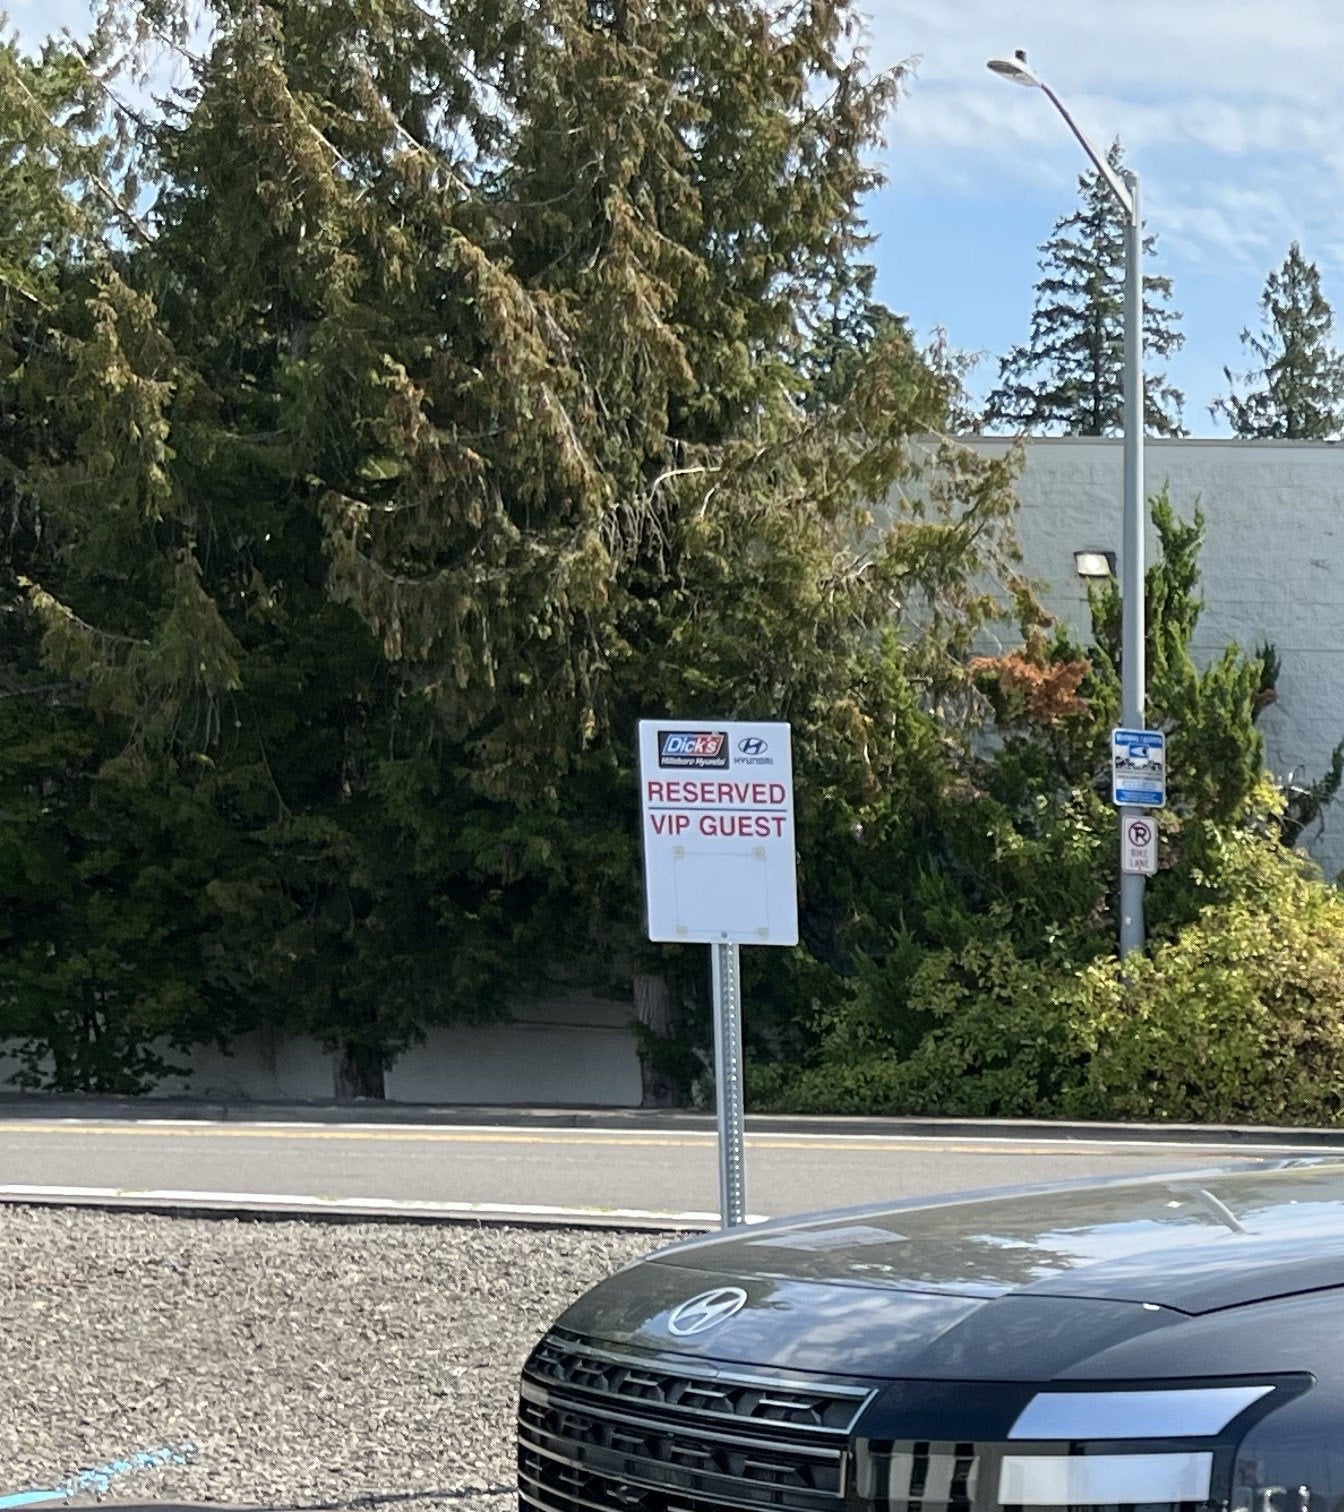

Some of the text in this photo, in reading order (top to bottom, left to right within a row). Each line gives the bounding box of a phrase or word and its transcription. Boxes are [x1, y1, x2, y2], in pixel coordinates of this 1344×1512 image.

[667, 735, 718, 753] Dick's
[648, 781, 786, 803] RESERVED
[650, 814, 787, 837] VIP GUEST
